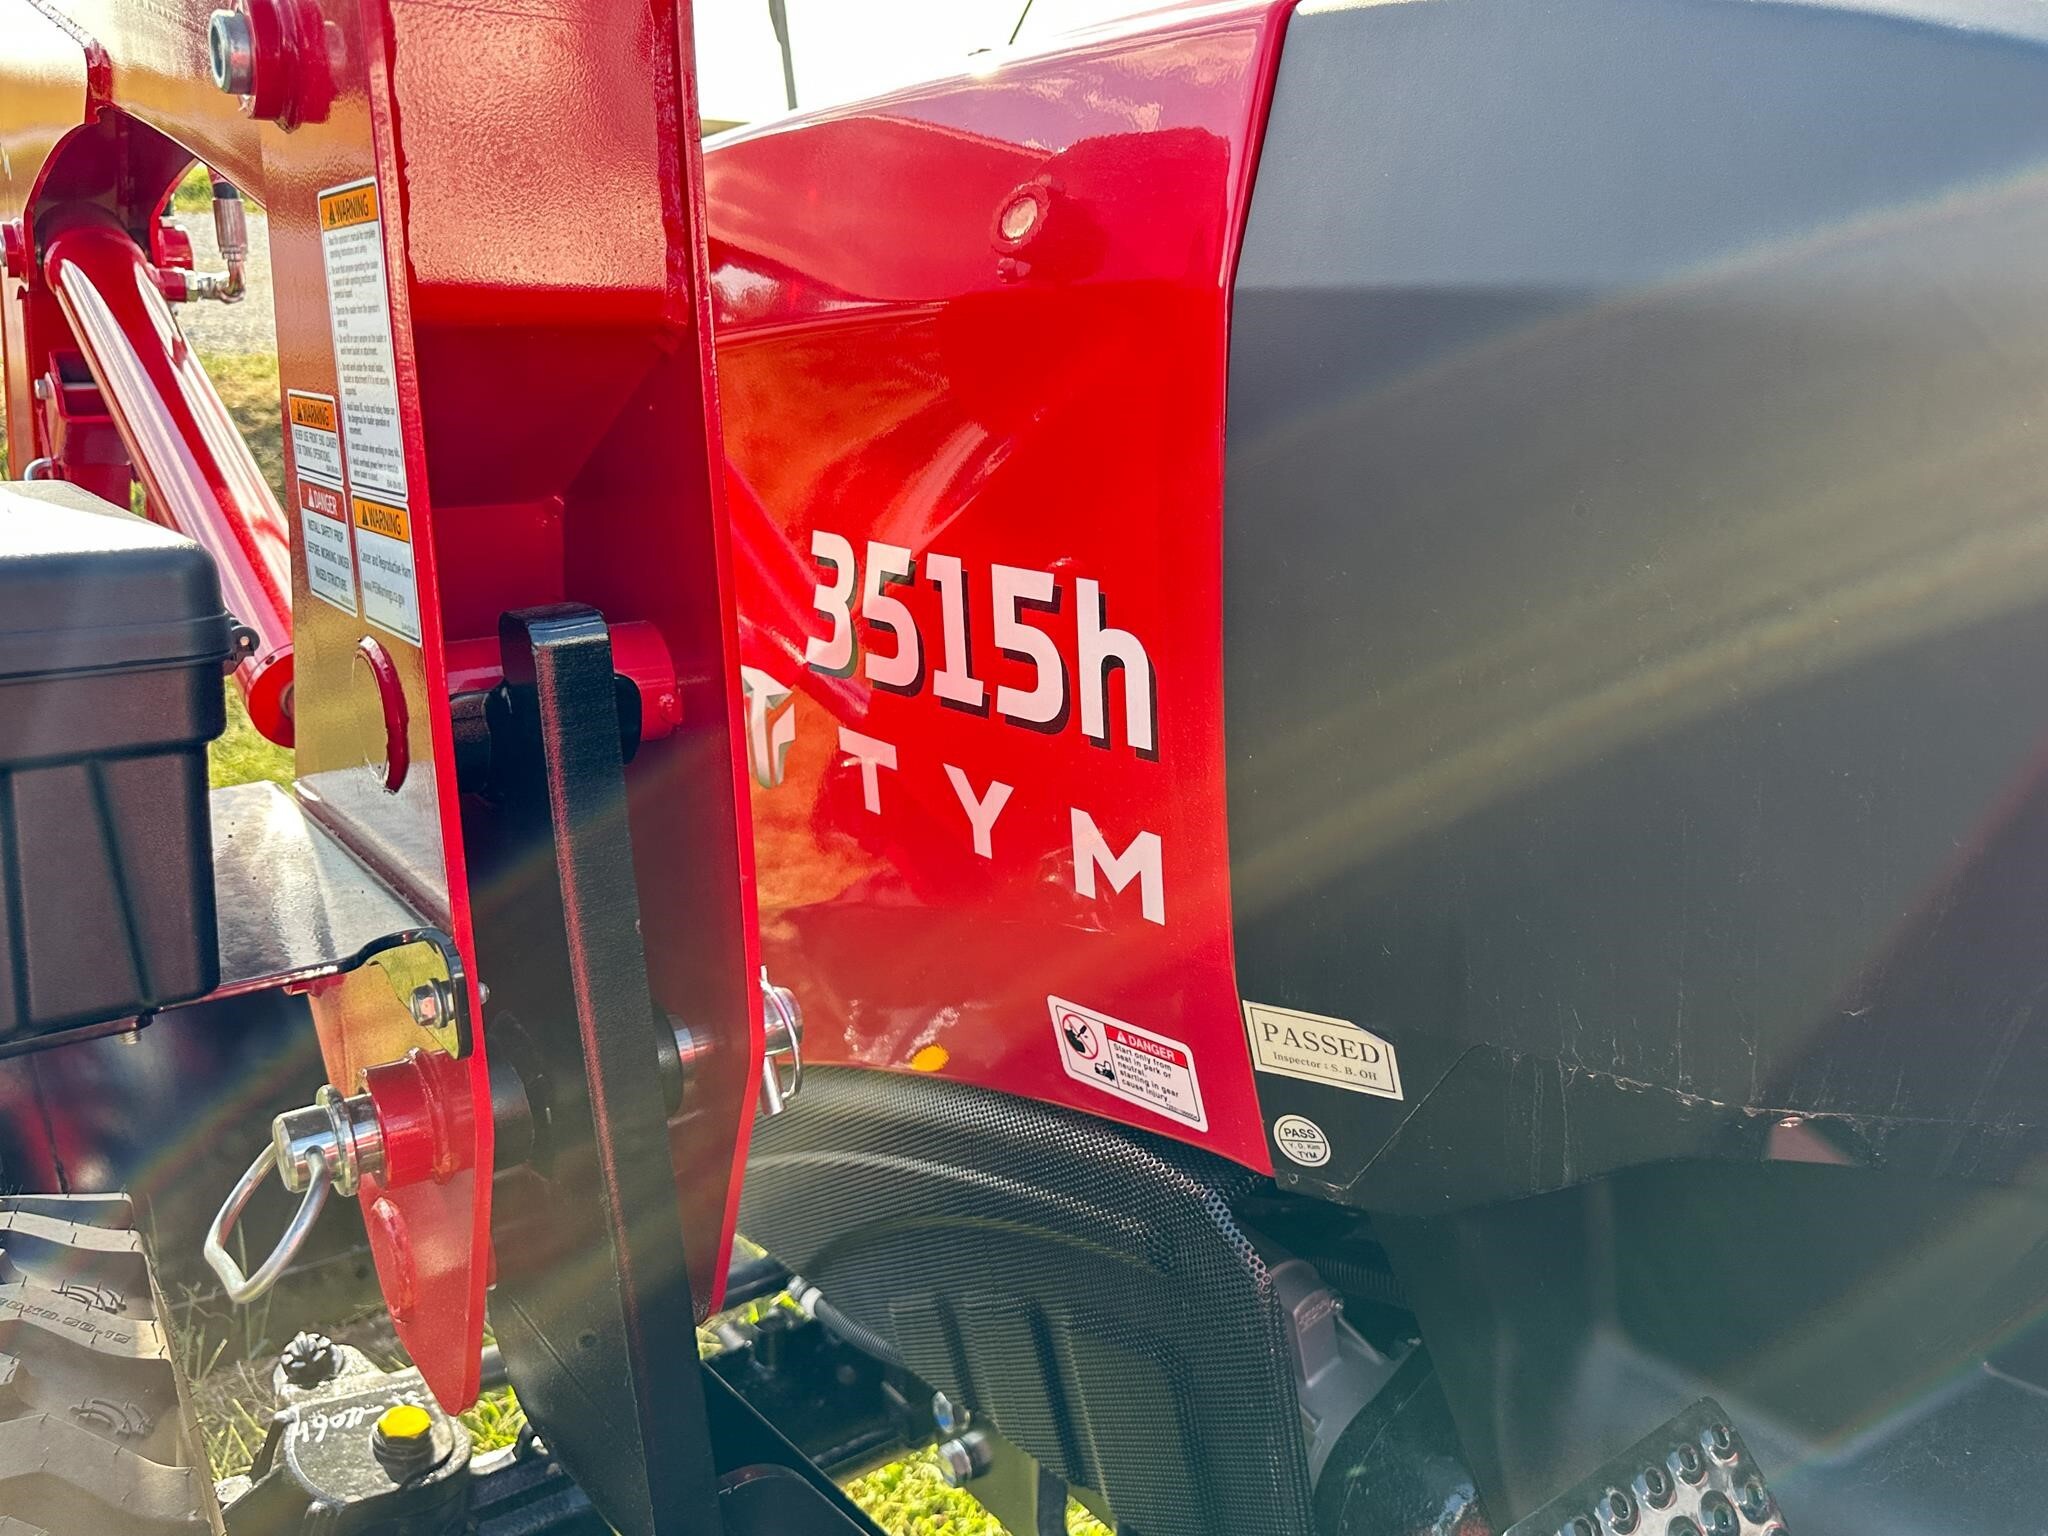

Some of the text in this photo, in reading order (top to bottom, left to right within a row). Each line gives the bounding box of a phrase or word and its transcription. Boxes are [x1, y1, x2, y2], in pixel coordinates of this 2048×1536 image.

[335, 193, 369, 222] WARNING
[302, 404, 329, 427] WARNING
[314, 490, 337, 515] DANGER
[369, 508, 401, 535] WARNING
[806, 530, 1159, 762] 3515h
[838, 726, 1165, 926] TYM
[1128, 1035, 1175, 1061] DANGER
[1262, 1022, 1380, 1064] PASSED
[1114, 1043, 1172, 1071] Start only from
[1116, 1053, 1132, 1063] seat
[1134, 1058, 1141, 1067] in
[1144, 1063, 1161, 1075] park
[1273, 1051, 1320, 1069] Inspector
[1122, 1079, 1144, 1092] cause
[1152, 1081, 1160, 1090] in
[1161, 1086, 1178, 1097] gear
[1284, 1127, 1316, 1139] PASS
[1300, 1151, 1317, 1159] TYM
